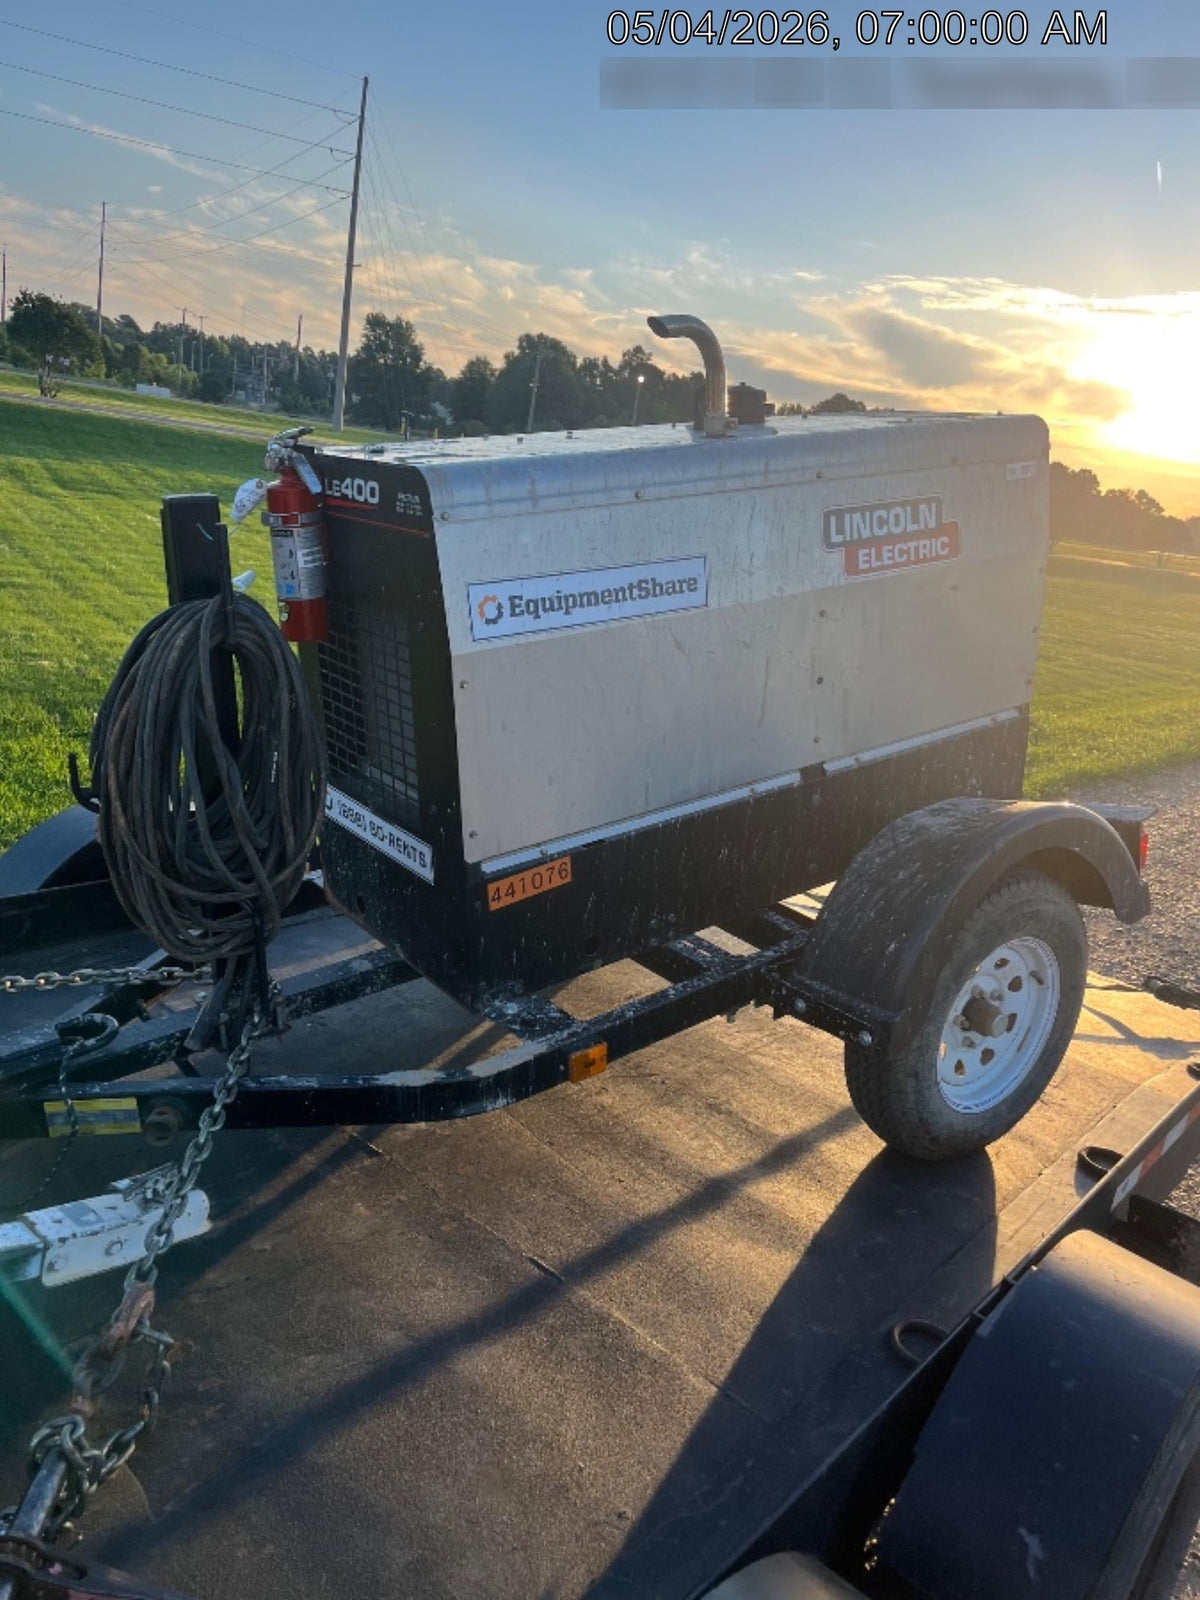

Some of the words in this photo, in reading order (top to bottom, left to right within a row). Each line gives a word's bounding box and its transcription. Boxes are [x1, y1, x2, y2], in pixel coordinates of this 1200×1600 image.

[829, 502, 937, 543] LINCOLN
[857, 536, 950, 570] ELECTRIC
[508, 575, 700, 620] EquipmentShare
[490, 860, 571, 904] 441076
